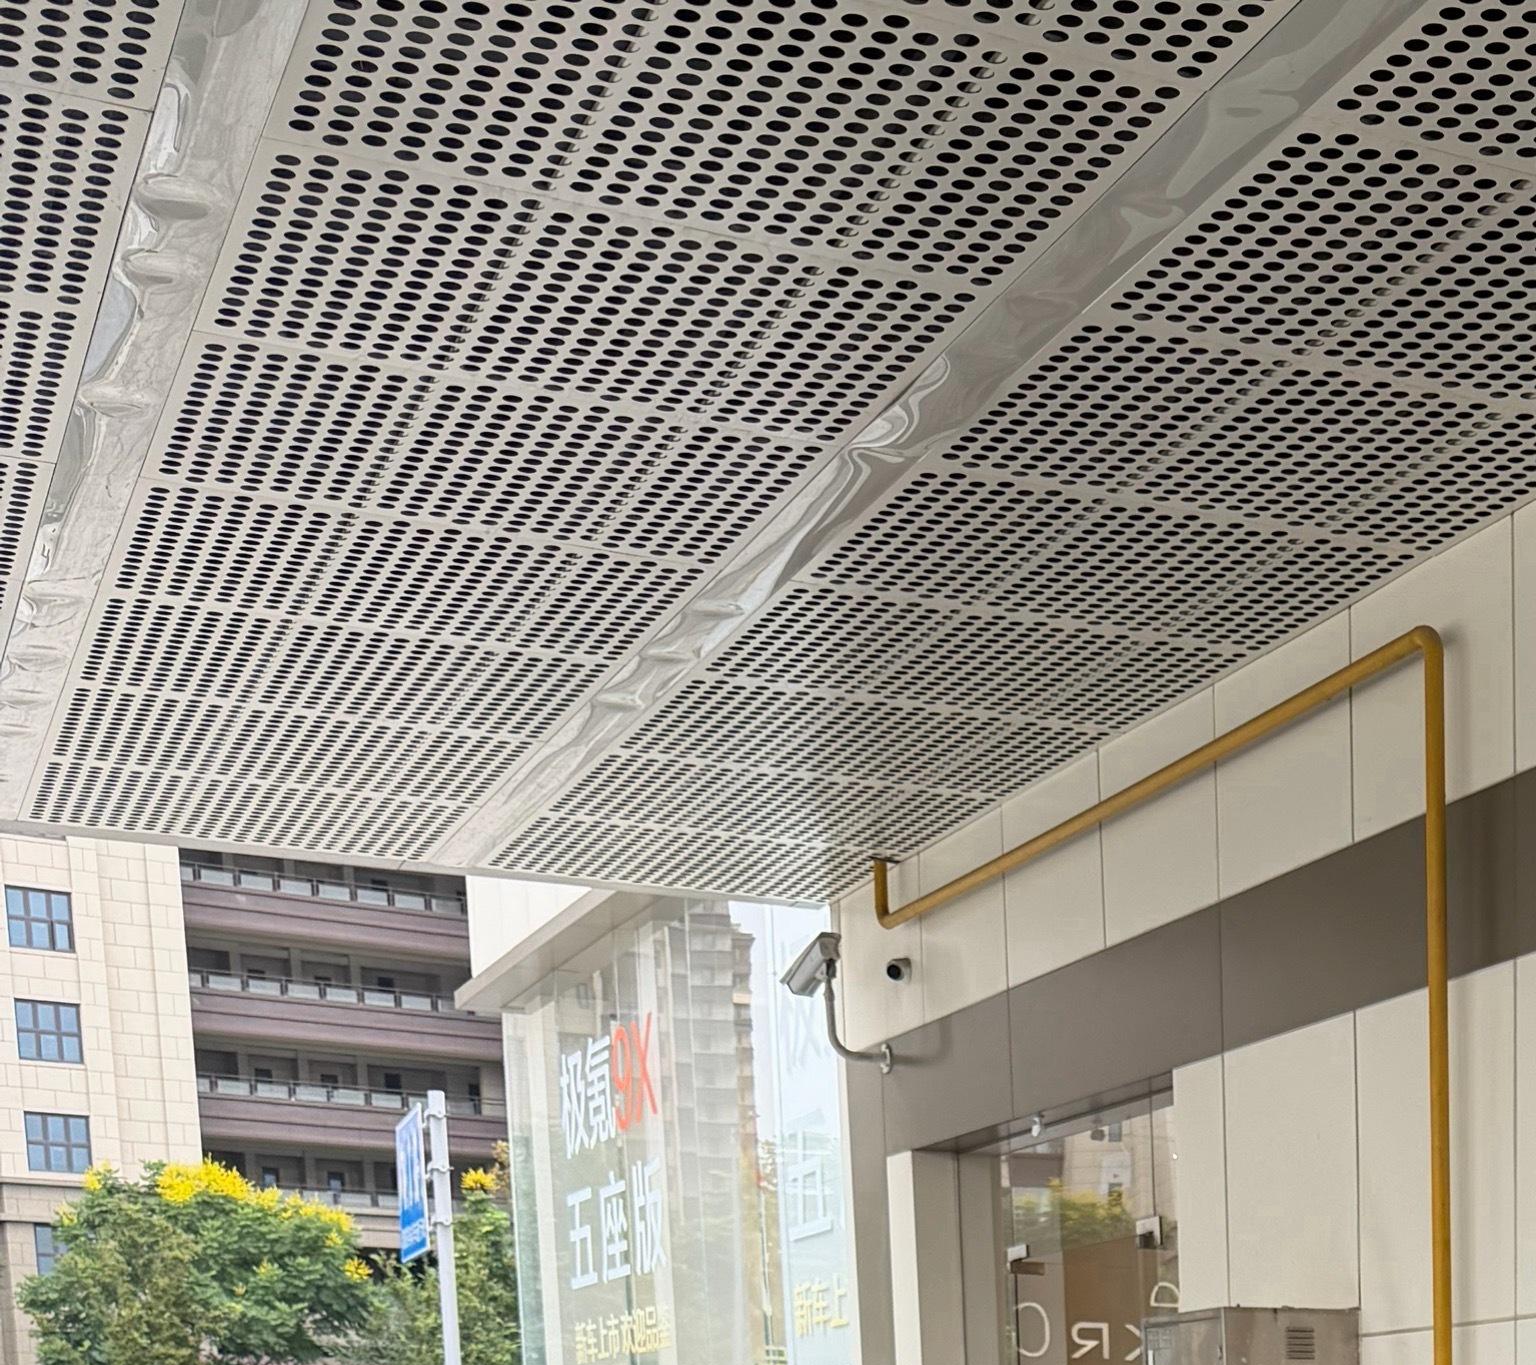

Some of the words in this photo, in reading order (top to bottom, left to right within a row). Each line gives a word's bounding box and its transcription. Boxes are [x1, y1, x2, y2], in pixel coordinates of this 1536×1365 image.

[560, 1012, 658, 1160] 极氪9X
[566, 1158, 667, 1290] 五座版
